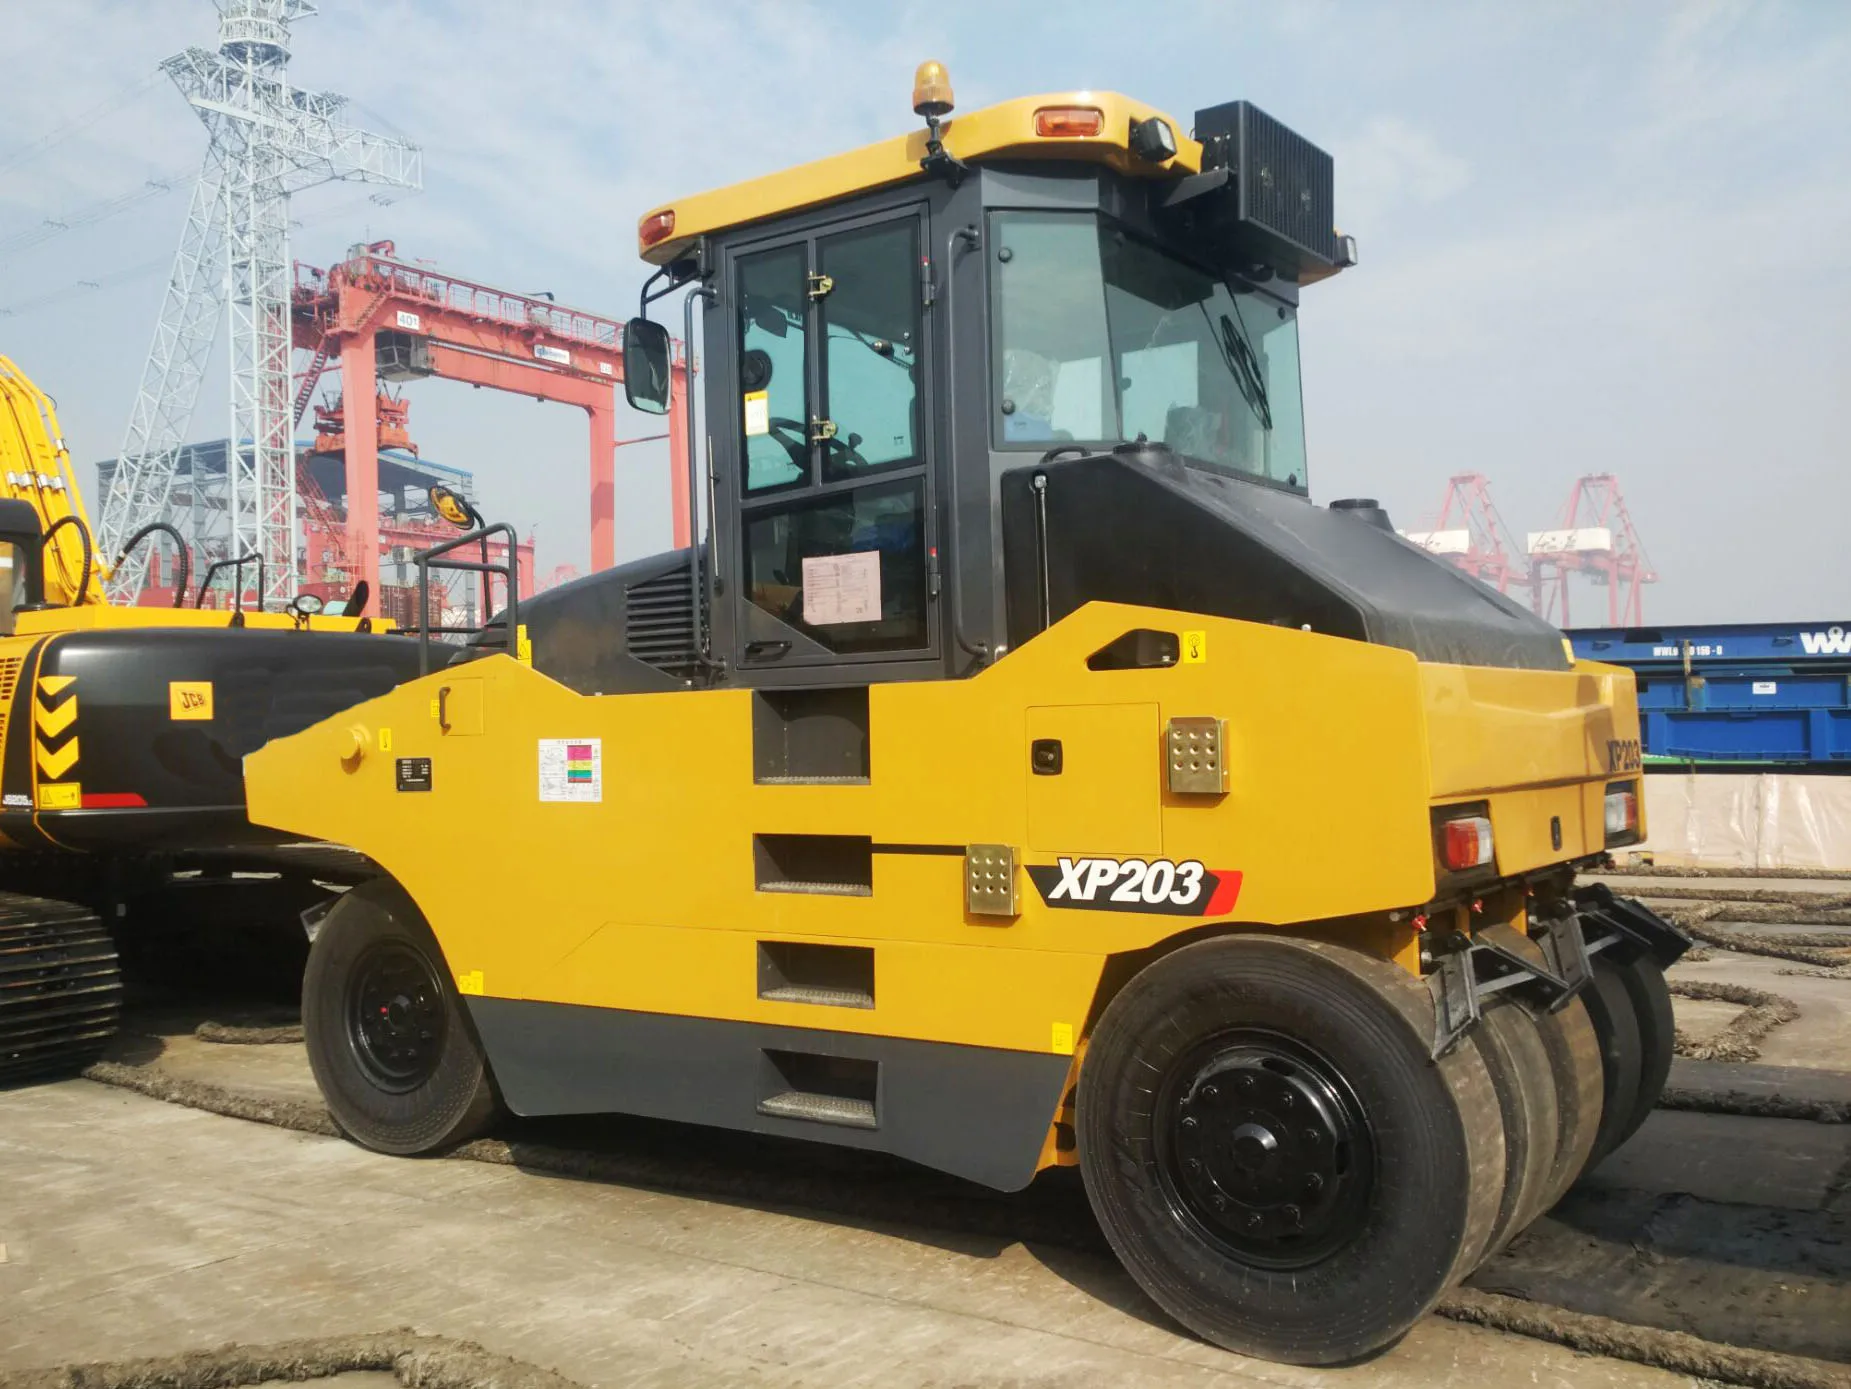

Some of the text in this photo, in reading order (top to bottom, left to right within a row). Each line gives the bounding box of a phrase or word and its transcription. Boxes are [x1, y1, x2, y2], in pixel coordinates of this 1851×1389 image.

[181, 691, 204, 709] JCB
[1606, 739, 1641, 772] XP203
[1048, 858, 1204, 905] XP203
